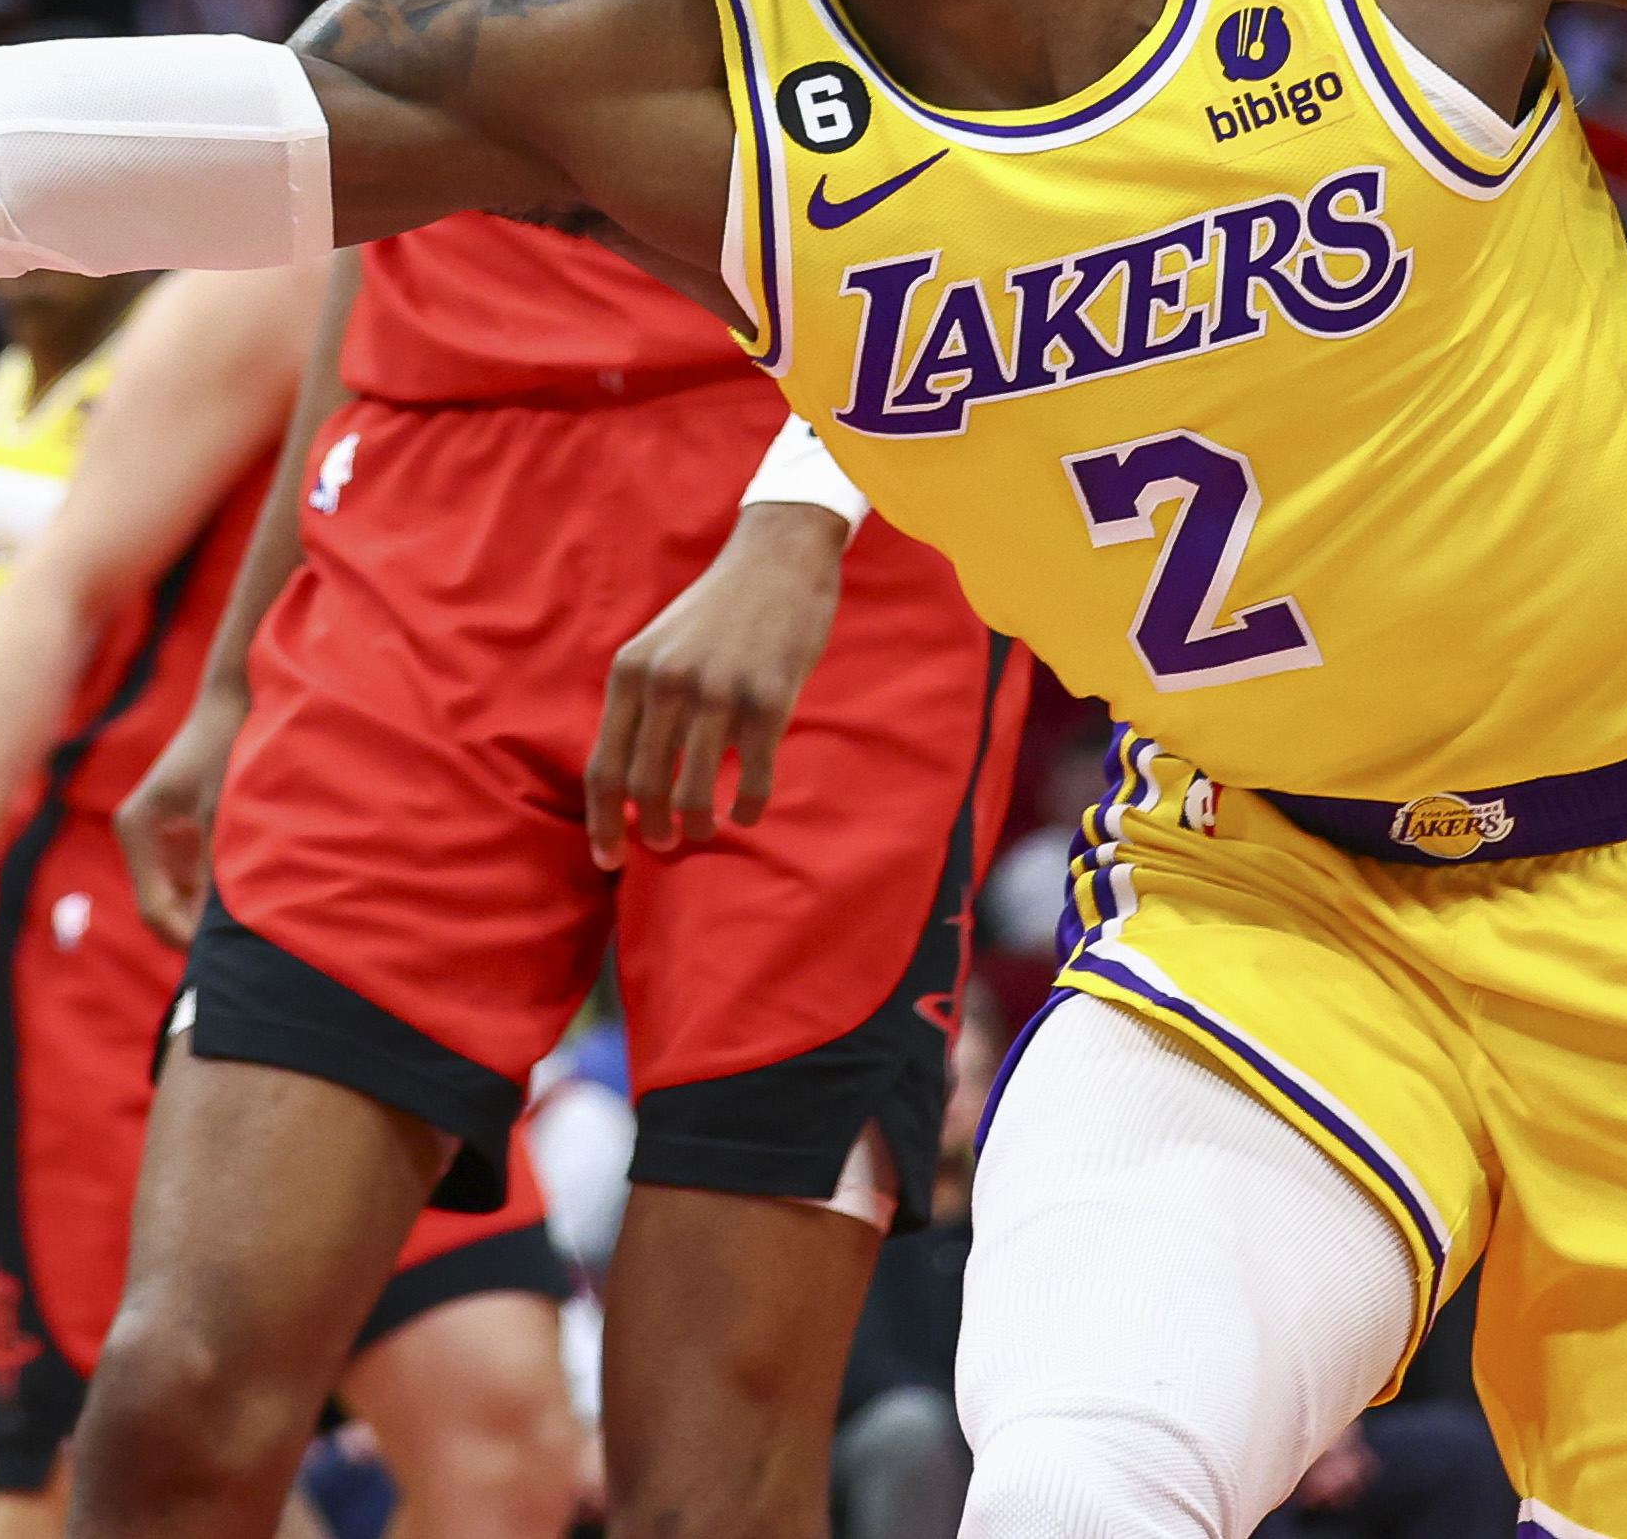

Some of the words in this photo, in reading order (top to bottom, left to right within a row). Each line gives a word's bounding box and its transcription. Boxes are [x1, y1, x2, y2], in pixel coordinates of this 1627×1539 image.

[794, 73, 854, 144] 6
[1205, 71, 1343, 143] bibigo
[832, 166, 1413, 440] LAKERS
[1061, 427, 1323, 692] 2
[1394, 810, 1510, 843] LAKERS
